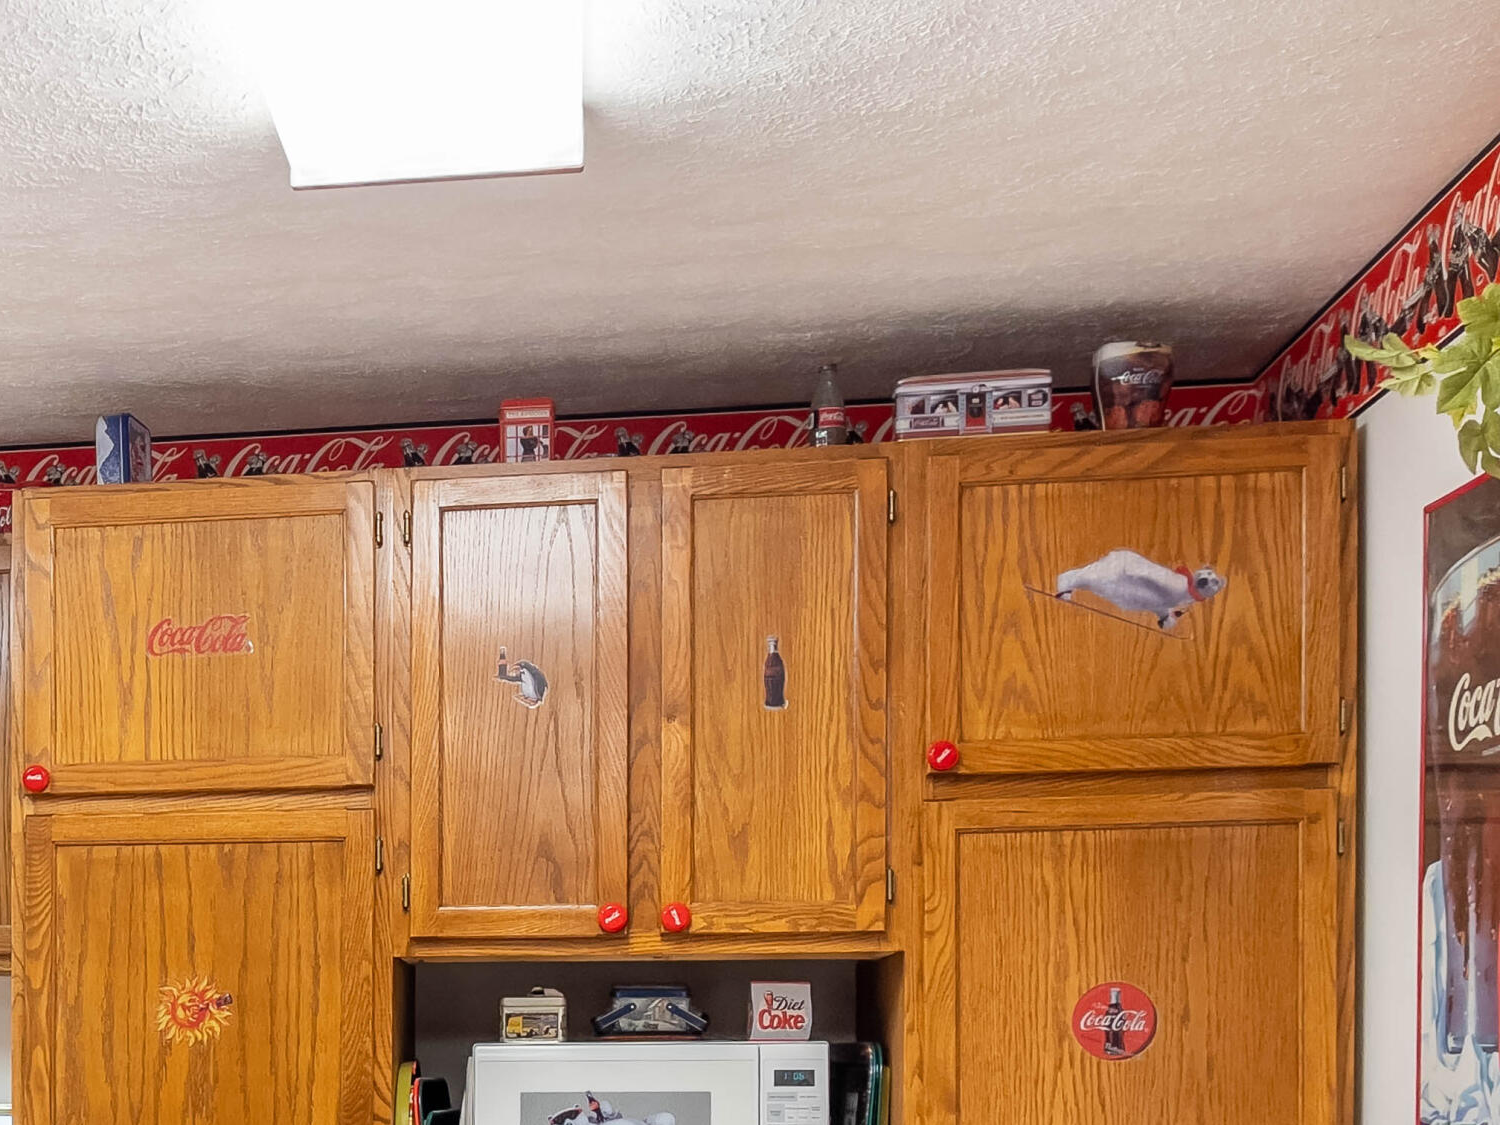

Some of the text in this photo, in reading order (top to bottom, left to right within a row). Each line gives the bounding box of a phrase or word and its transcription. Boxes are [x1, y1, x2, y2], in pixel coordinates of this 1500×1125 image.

[147, 615, 248, 657] Coca-Cola
[773, 997, 804, 1012] Diet
[758, 1009, 805, 1030] Coke
[1079, 1009, 1148, 1032] Coca-Cola
